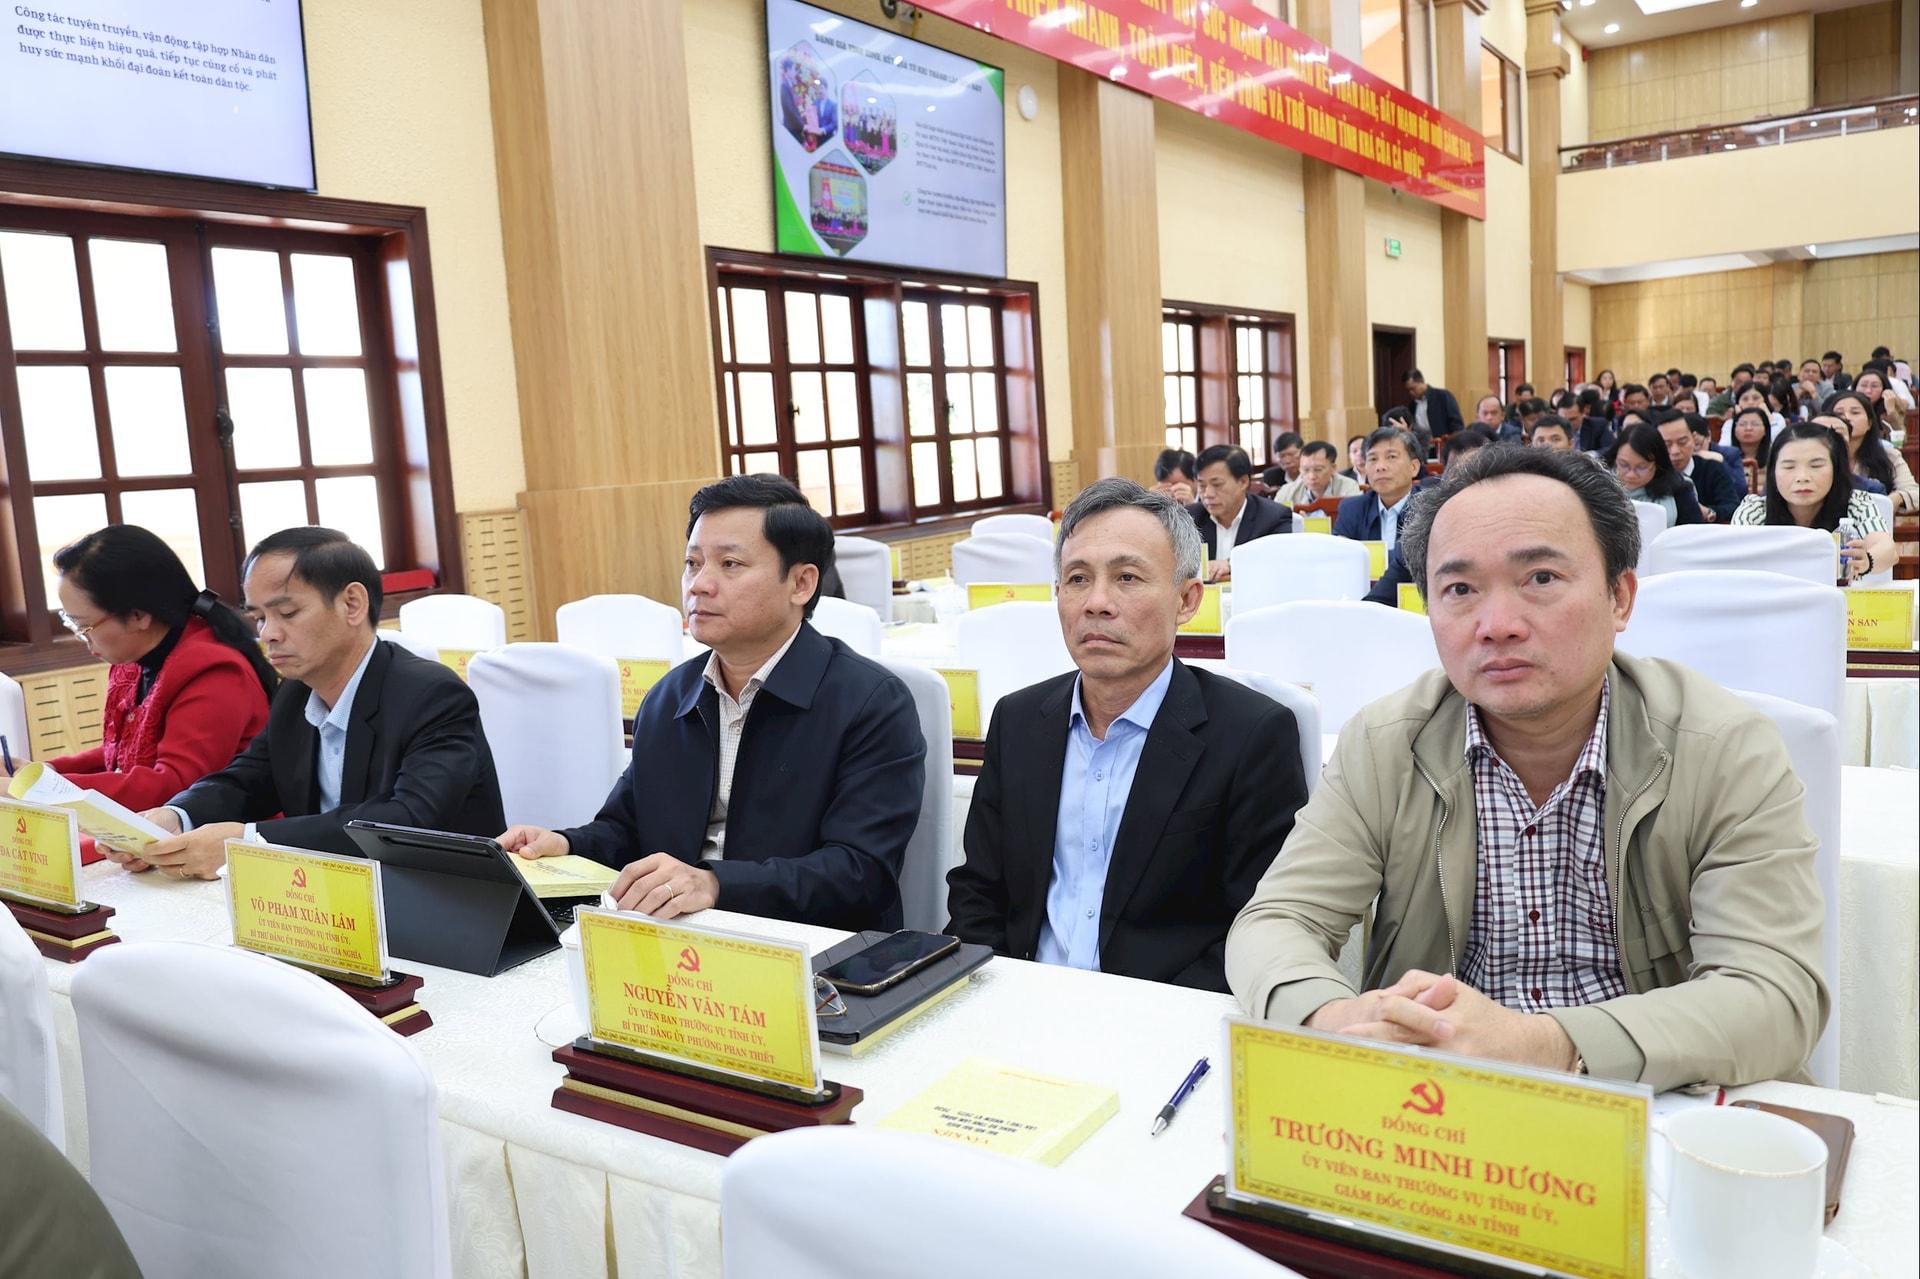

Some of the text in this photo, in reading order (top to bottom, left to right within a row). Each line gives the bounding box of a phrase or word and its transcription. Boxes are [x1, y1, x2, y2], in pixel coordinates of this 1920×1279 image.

[14, 5, 46, 22] Công
[46, 12, 66, 24] tác
[67, 16, 100, 31] tuyên
[143, 31, 162, 43] vận
[192, 40, 209, 52] tập
[211, 43, 229, 57] hợp
[231, 48, 257, 61] Nhân
[258, 52, 276, 65] dân
[17, 24, 46, 39] được
[49, 30, 76, 45] thực
[79, 35, 105, 50] hiện
[108, 40, 133, 55] hiệu
[160, 49, 181, 64] tiếp
[183, 55, 200, 67] tục
[229, 62, 241, 74] cố
[242, 65, 254, 77] và
[255, 69, 278, 81] phát
[1228, 15, 1262, 62] MẠNH
[19, 41, 43, 57] huy
[44, 47, 65, 60] sức
[66, 52, 99, 65] mạnh
[101, 56, 126, 71] khối
[127, 62, 144, 75] đại
[145, 64, 171, 78] đoàn
[173, 68, 189, 81] kết
[191, 73, 214, 86] toàn
[215, 77, 234, 90] dân
[1127, 22, 1168, 72] TOÀN
[1268, 86, 1285, 123] VÀ
[1285, 91, 1305, 132] TRỞ
[1306, 104, 1338, 145] THÀNH
[1338, 113, 1358, 153] TỈNH
[1358, 128, 1375, 160] KHÁ
[1375, 131, 1392, 167] CỦA
[1392, 139, 1403, 172] CẢ
[1857, 618, 1878, 627] SAN
[29, 850, 48, 866] VINH
[250, 896, 356, 931] VÕ PHẠM XUÂN LÂM
[623, 982, 767, 1028] NGUYỄN VĂN TÁM
[667, 972, 713, 993] ĐỒNG CHÍ
[1381, 1115, 1466, 1144] ĐỒNG CHÍ
[1270, 1115, 1597, 1206] TRƯƠNG MINH ĐƯƠNG
[1302, 1150, 1560, 1226] ỦY VIÊN BAN THƯỜNG VỤ TỈNH ỦY,
[1334, 1182, 1521, 1238] GIÁM ĐỐC CÔNG AN TỈNH
